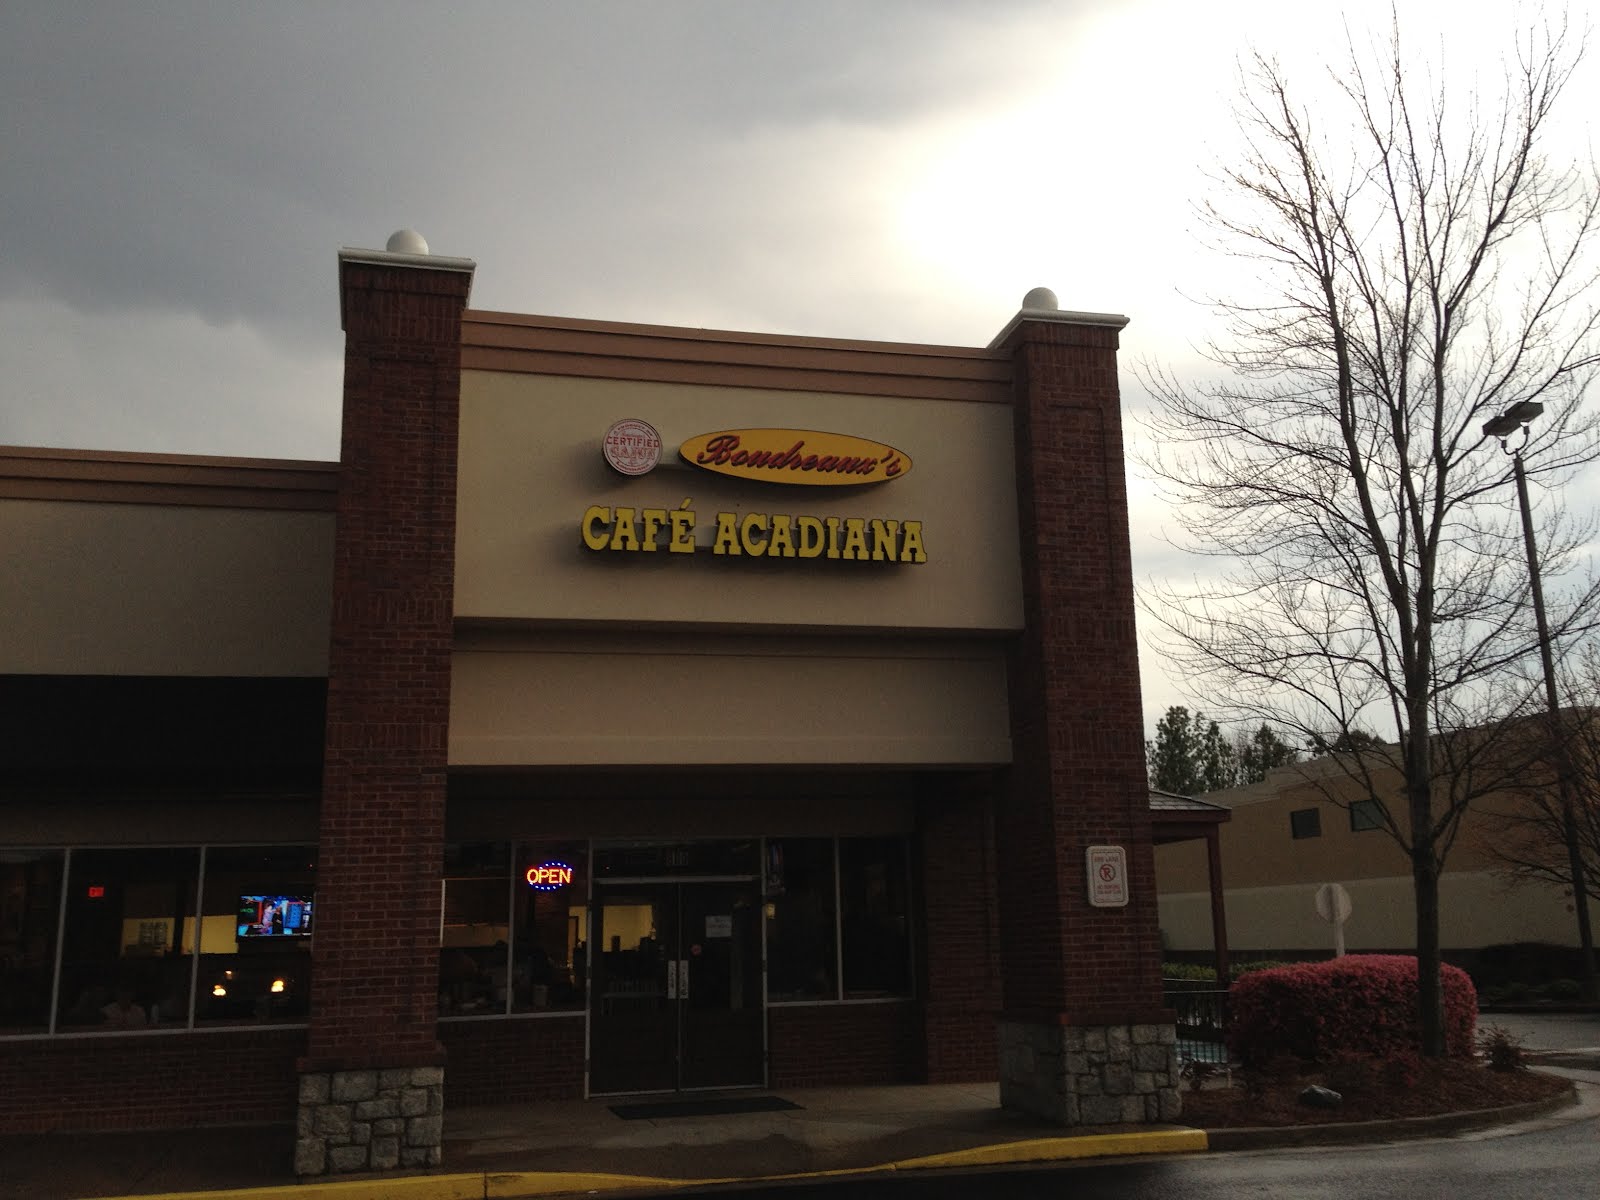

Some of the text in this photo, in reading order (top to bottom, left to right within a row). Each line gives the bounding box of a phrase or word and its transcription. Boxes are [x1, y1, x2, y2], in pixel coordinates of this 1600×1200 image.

[606, 435, 660, 448] CERTIFIED
[581, 497, 927, 564] CAFÉ ACADIANA
[526, 867, 572, 884] OPEN
